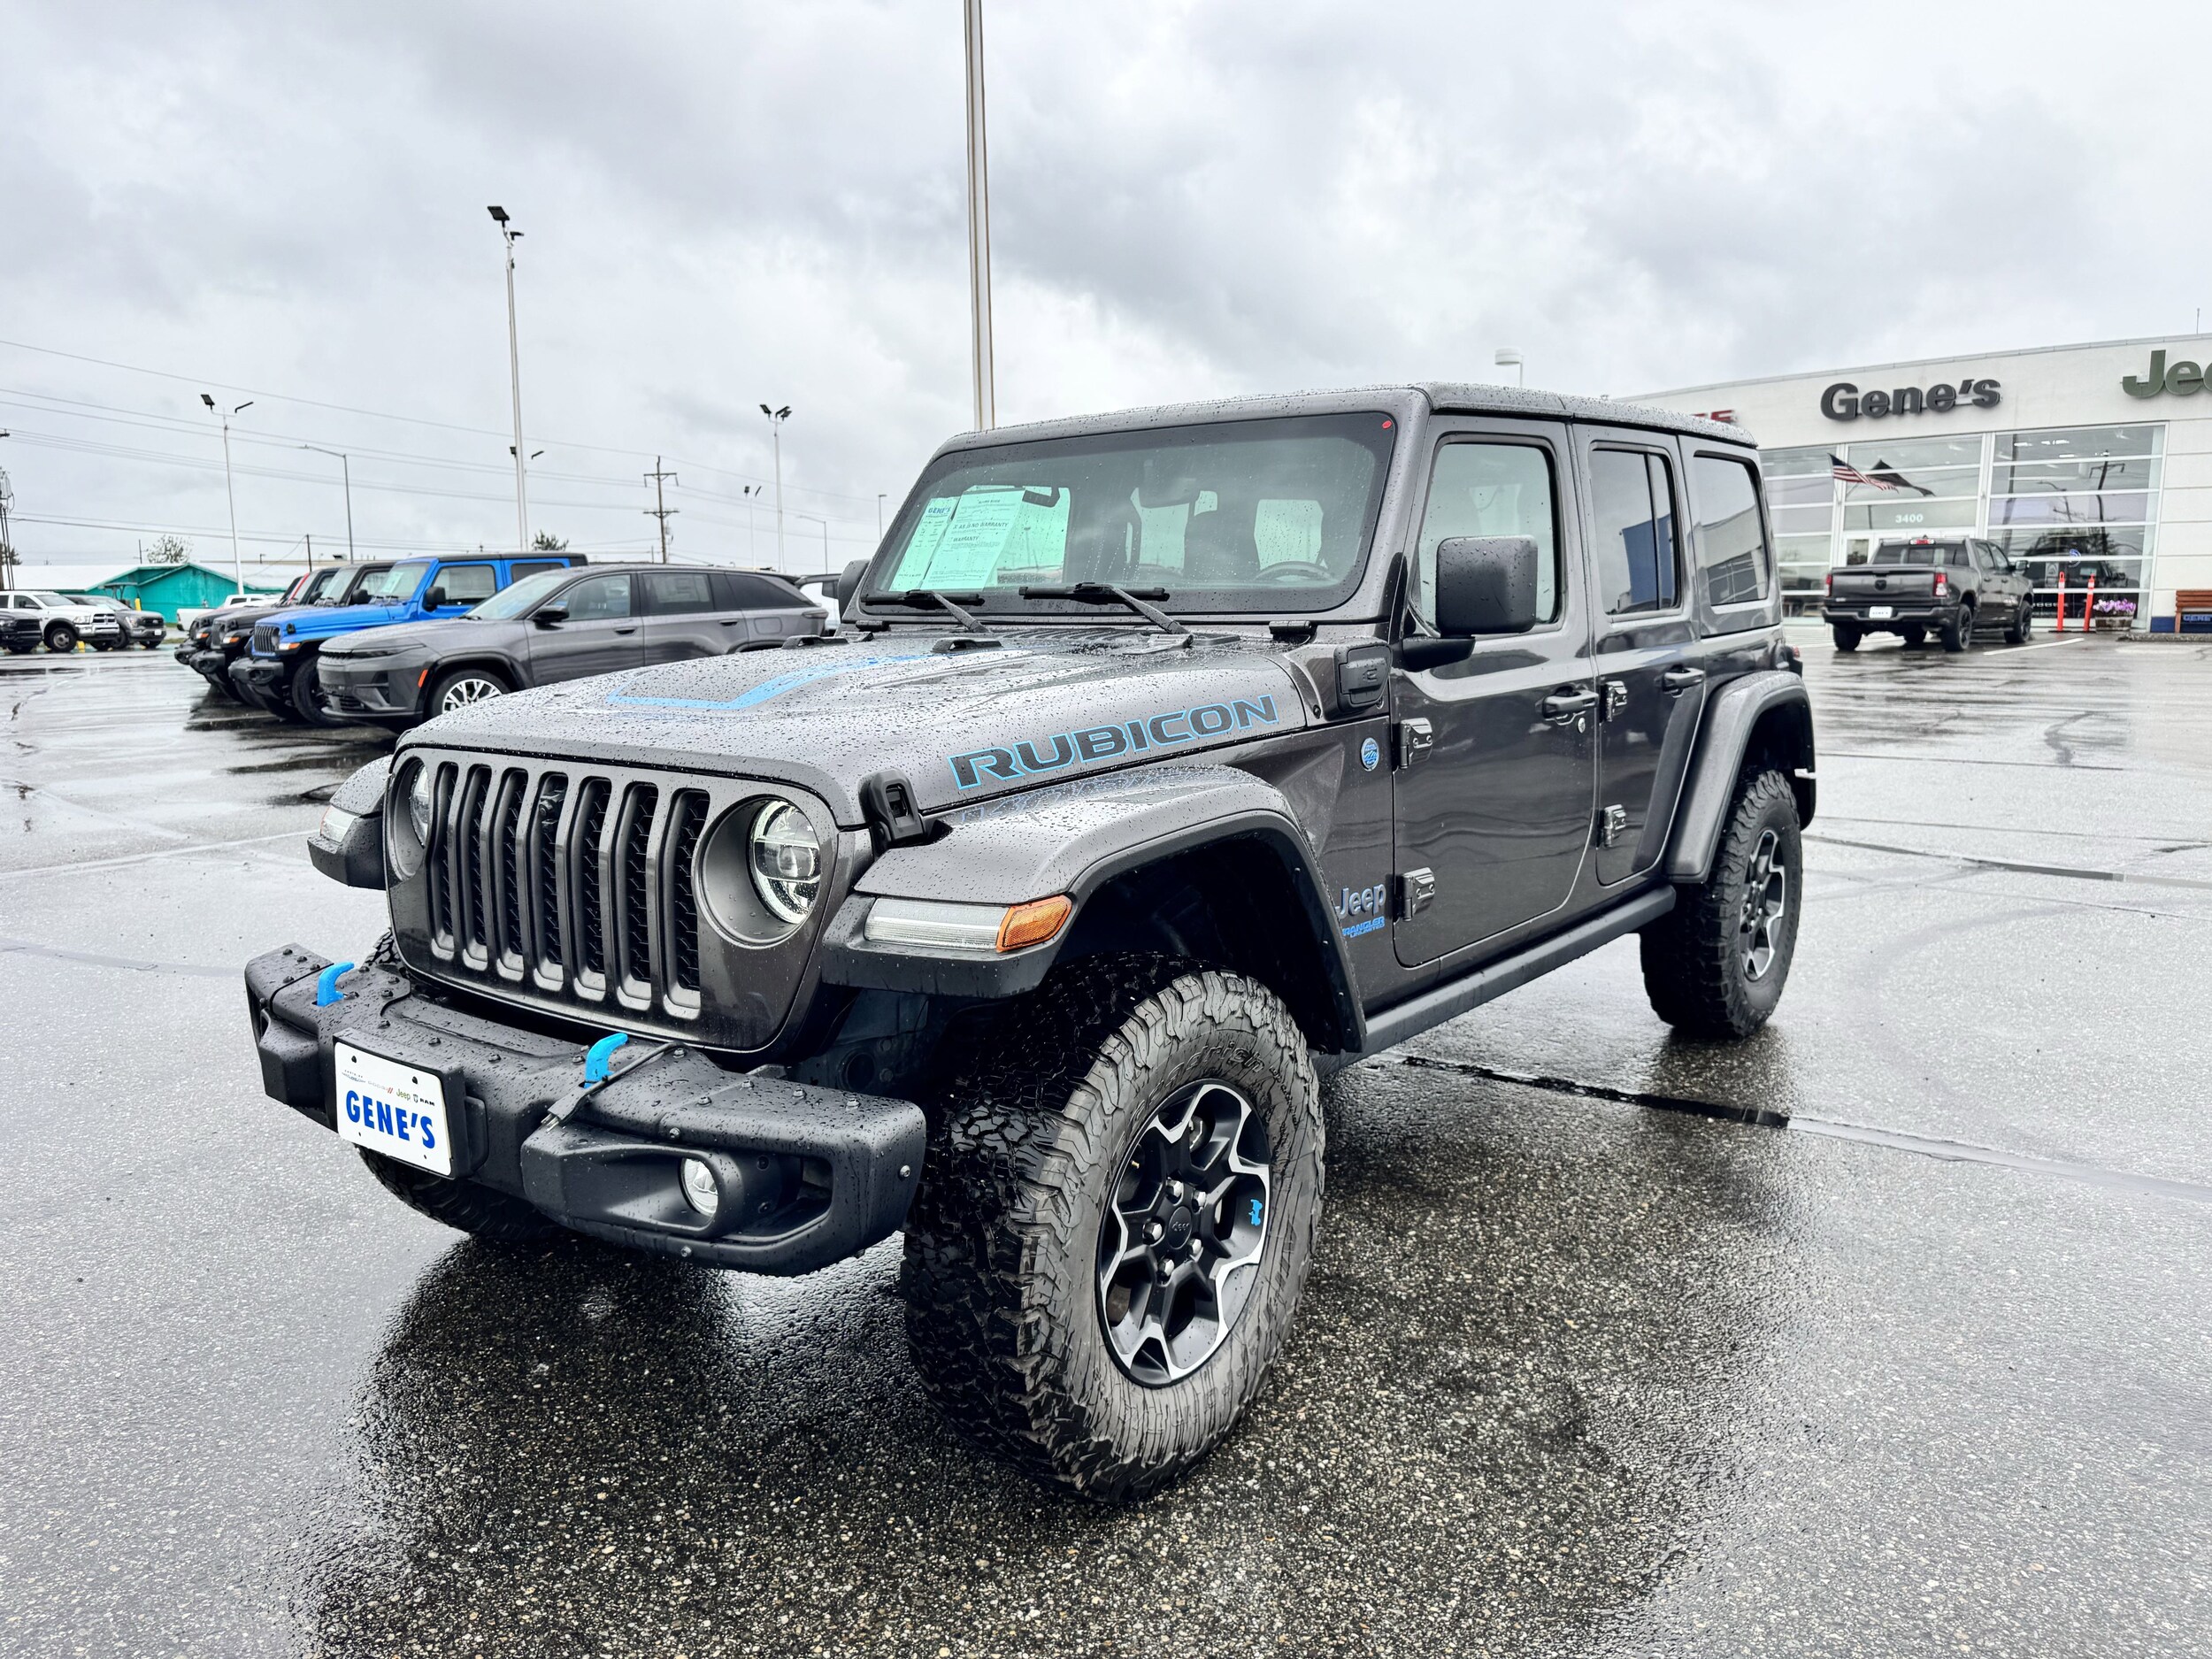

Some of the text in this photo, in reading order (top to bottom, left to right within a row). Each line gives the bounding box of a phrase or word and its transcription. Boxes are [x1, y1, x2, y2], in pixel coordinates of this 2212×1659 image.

[2122, 349, 2212, 398] Je
[1820, 379, 2001, 421] Gene's
[1895, 513, 1924, 523] 3400
[948, 694, 1279, 789] RUBICON
[1334, 883, 1386, 919] Jeep
[1342, 916, 1385, 936] RANGLER
[396, 1088, 435, 1107] Jeep RAM
[346, 1090, 435, 1149] GENE'S
